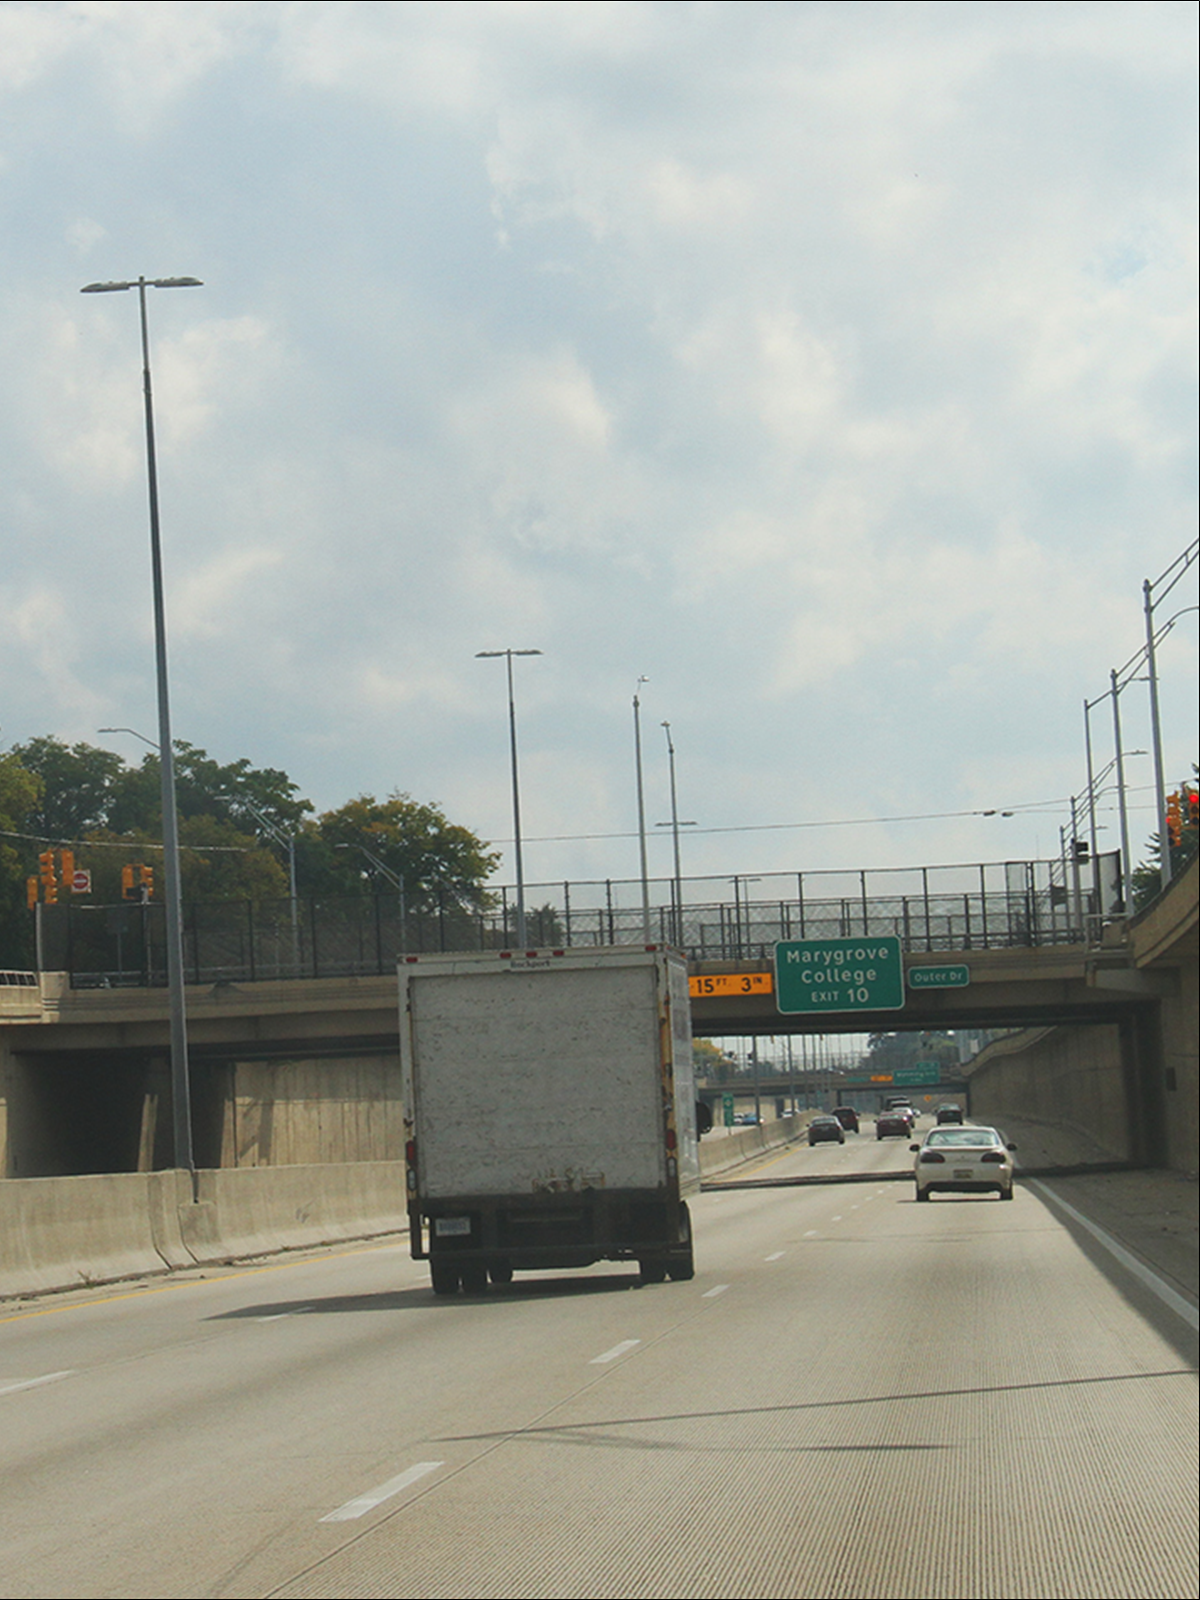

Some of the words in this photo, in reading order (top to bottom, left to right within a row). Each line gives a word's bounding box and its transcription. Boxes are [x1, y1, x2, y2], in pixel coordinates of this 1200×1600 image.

[786, 947, 888, 965] Marygrove
[801, 969, 877, 985] College
[914, 972, 947, 982] Outer
[950, 971, 963, 981] Dr
[697, 978, 714, 994] 15
[741, 977, 751, 992] 3
[811, 991, 839, 1002] EXIT
[847, 987, 869, 1003] 10
